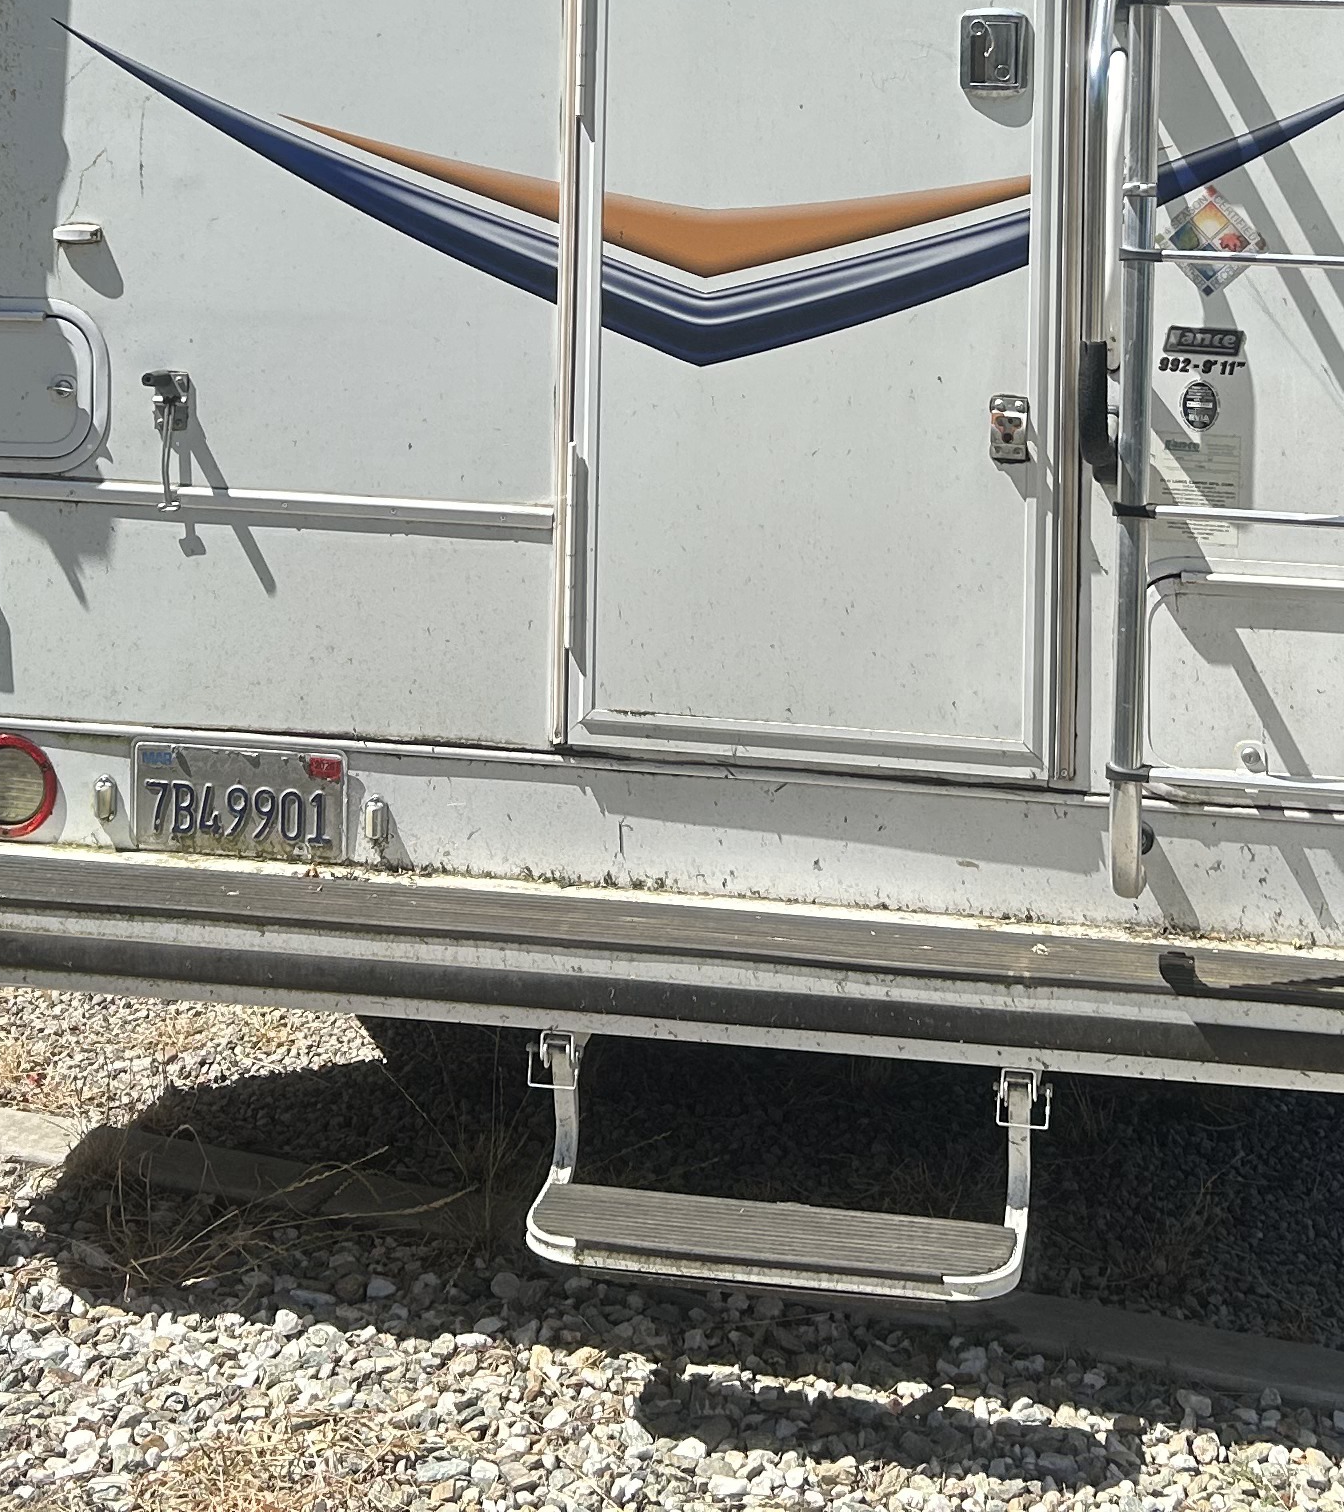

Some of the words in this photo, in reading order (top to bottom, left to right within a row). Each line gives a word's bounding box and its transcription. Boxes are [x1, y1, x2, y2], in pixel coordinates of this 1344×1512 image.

[1170, 194, 1209, 229] SEASON
[1214, 195, 1259, 242] CERTIFIED
[1166, 329, 1237, 352] Lance
[145, 779, 332, 847] 7B49901
